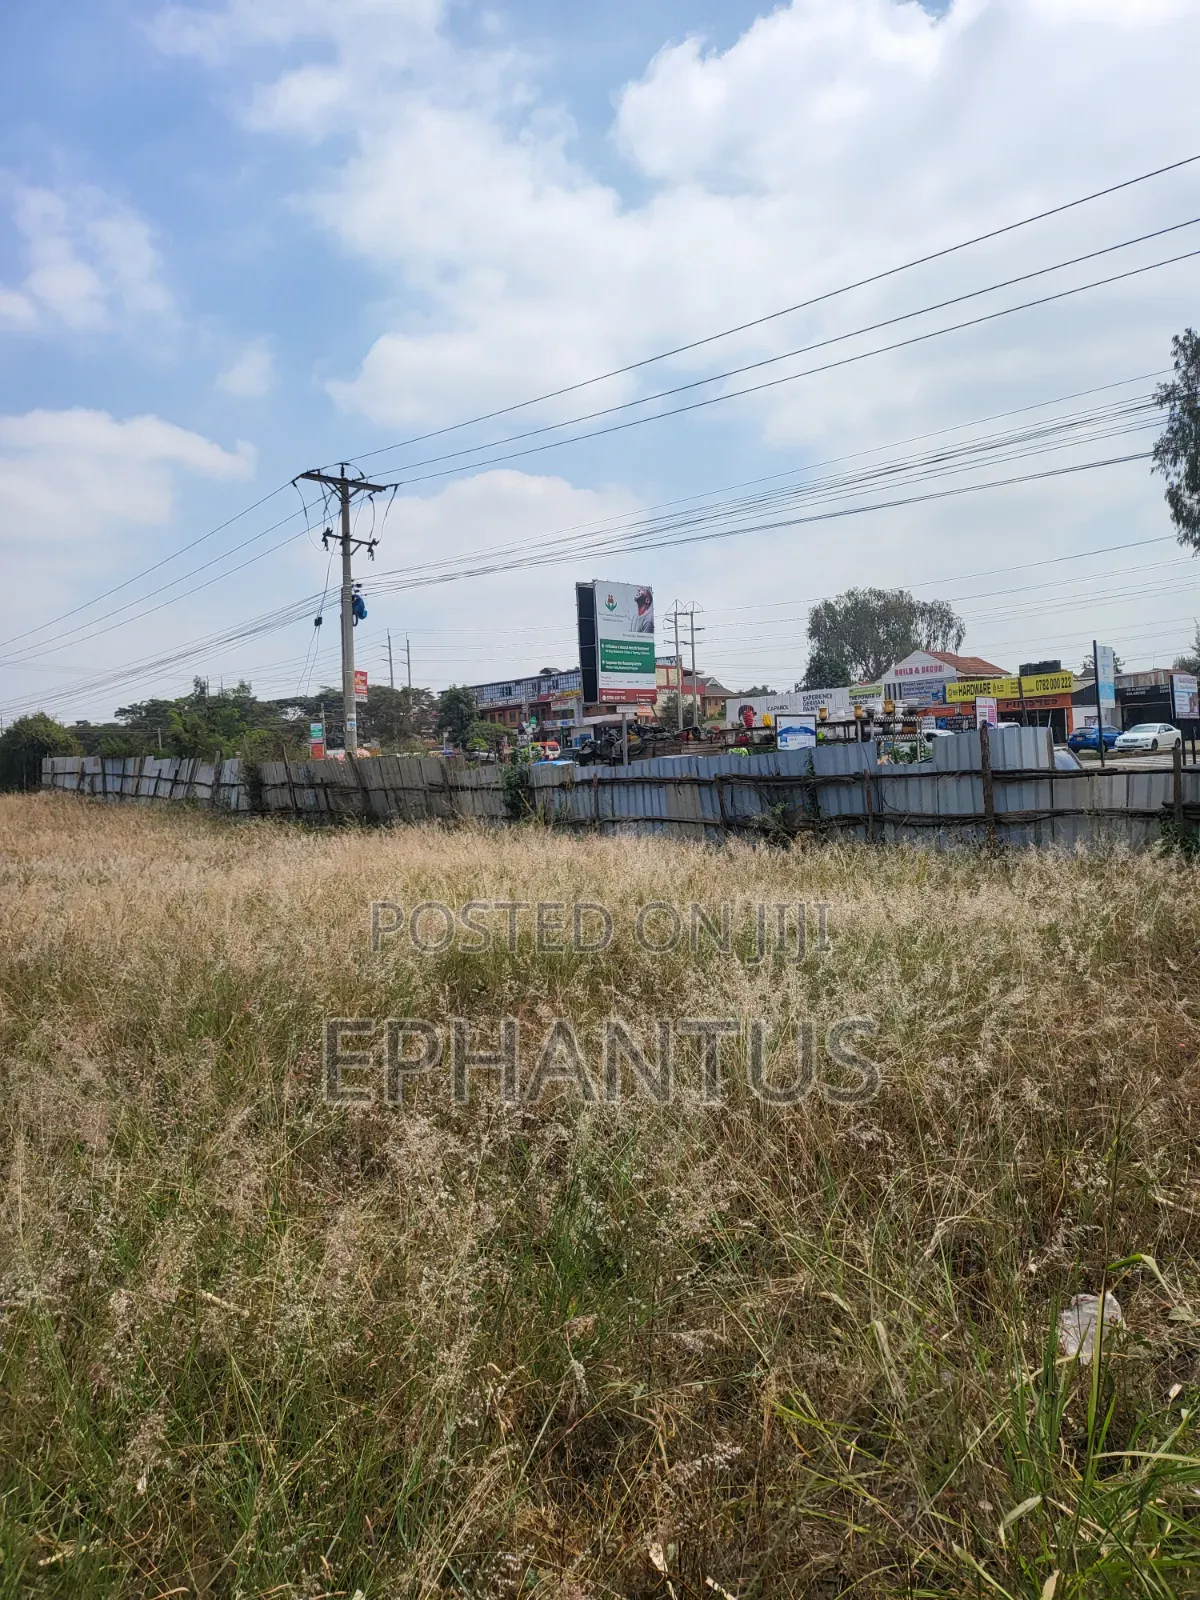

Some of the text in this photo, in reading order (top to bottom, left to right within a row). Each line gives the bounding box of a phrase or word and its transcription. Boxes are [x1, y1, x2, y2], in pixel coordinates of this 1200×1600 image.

[894, 664, 943, 676] BUILD & DECOR
[1061, 676, 1072, 688] 222
[958, 682, 991, 696] HARDWARE
[802, 693, 833, 701] EXPERIENCE
[802, 699, 825, 707] GERMAN
